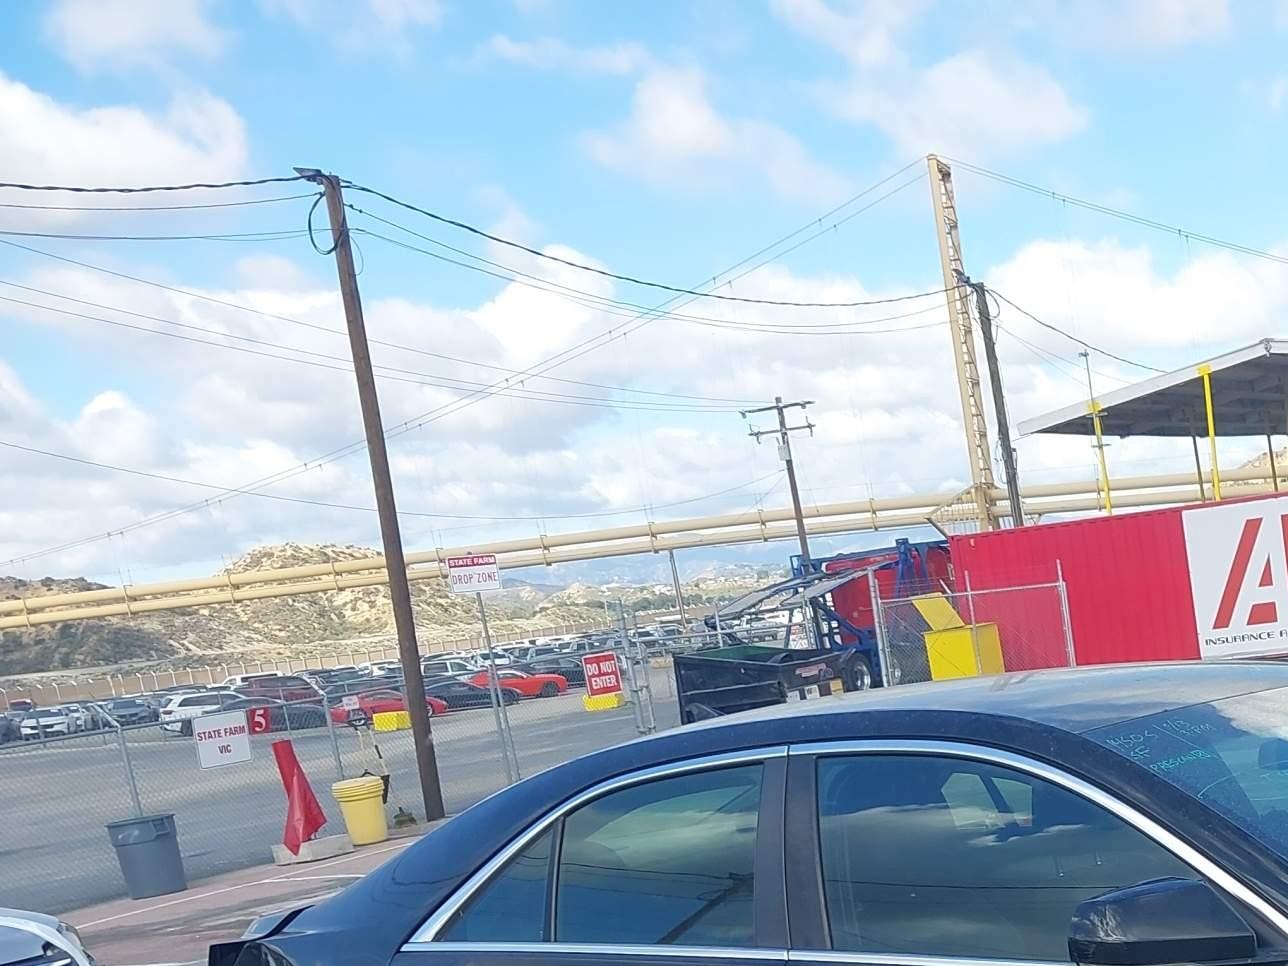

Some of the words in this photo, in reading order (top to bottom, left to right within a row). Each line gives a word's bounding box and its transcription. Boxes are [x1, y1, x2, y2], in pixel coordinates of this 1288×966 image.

[449, 558, 473, 567] STATE
[473, 556, 494, 565] FARM
[452, 573, 474, 585] DROP
[476, 571, 497, 583] ZONE
[1205, 630, 1275, 646] INSURANCE
[586, 663, 599, 676] DO
[600, 661, 616, 674] NOT
[591, 675, 617, 690] ENTER
[254, 710, 266, 732] 5
[197, 729, 222, 742] STATE
[223, 724, 246, 737] FARM
[218, 744, 232, 755] VIC
